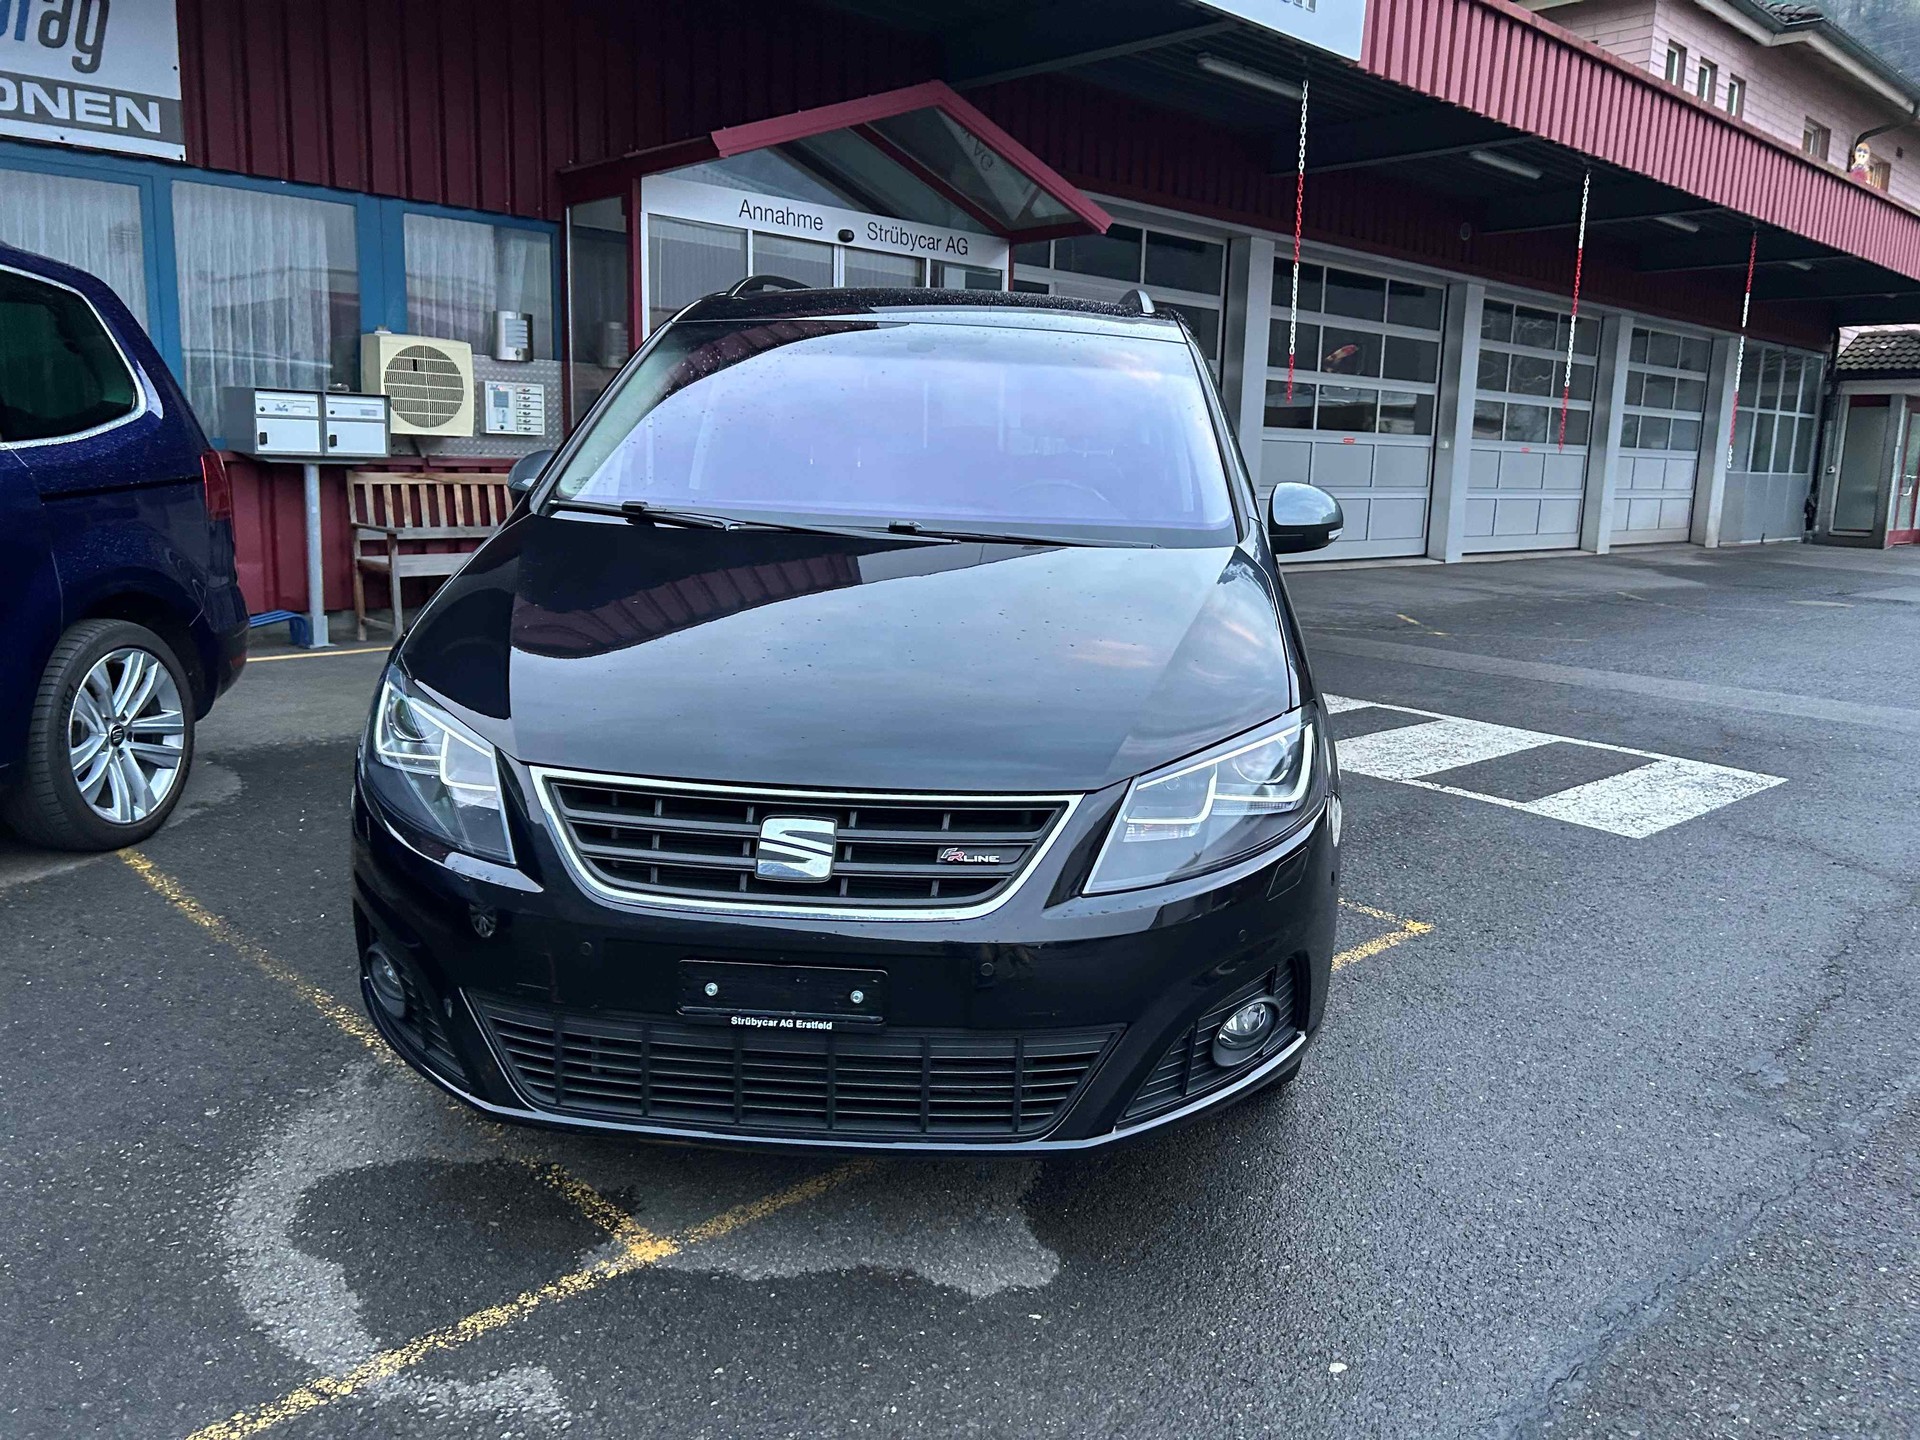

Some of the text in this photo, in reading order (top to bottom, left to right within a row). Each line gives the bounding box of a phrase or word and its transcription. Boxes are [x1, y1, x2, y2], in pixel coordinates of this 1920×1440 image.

[0, 0, 110, 74] ag
[739, 199, 824, 231] Annahme
[867, 222, 969, 256] Strübycar AG
[731, 1016, 833, 1030] Strübycar AG Erstfeld
